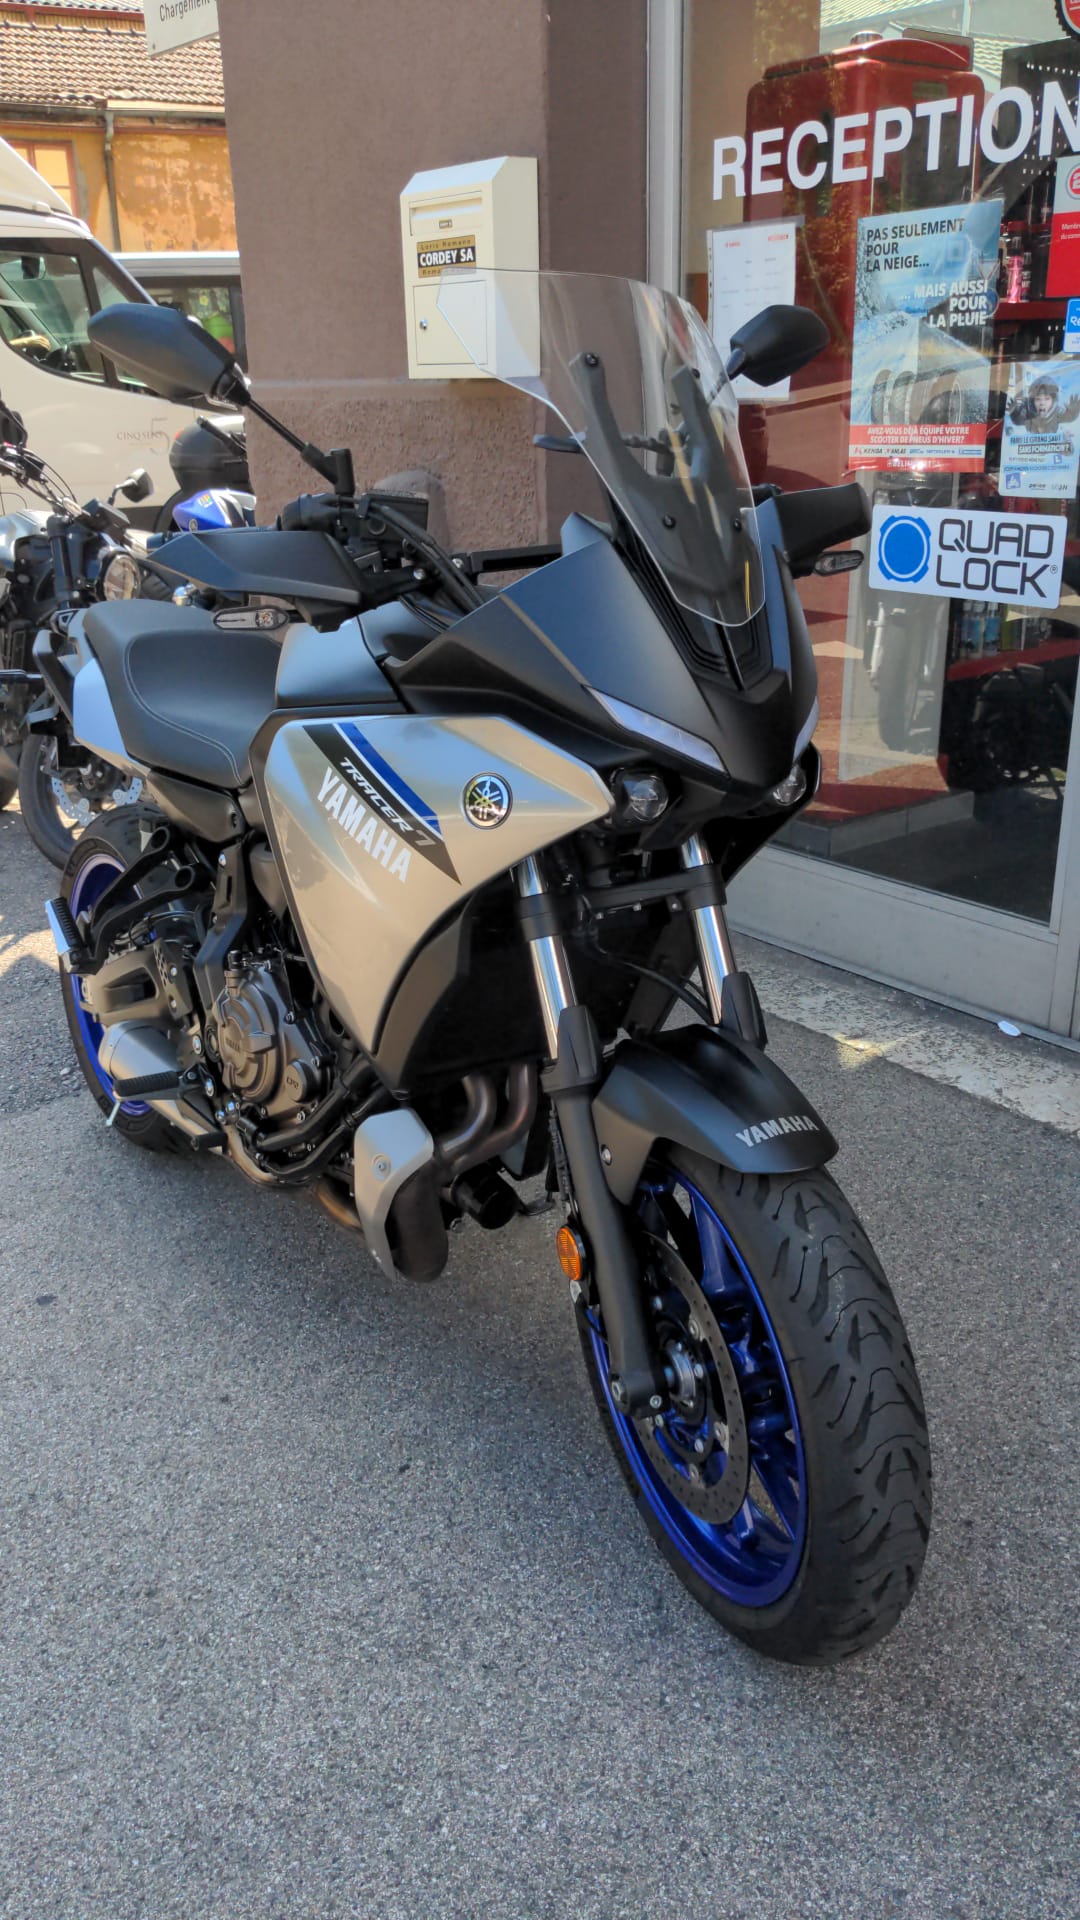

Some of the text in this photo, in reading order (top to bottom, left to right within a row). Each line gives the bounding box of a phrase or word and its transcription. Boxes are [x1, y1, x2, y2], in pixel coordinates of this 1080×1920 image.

[713, 80, 1080, 200] RECEPTION
[866, 218, 965, 242] PAS SEULEMENT
[420, 247, 474, 267] CORDEY SA
[866, 242, 899, 257] POUR
[866, 260, 881, 273] LA
[914, 283, 946, 298] MAIS
[950, 280, 988, 296] AUSSI
[950, 296, 987, 312] POUR
[929, 312, 987, 328] LA PLUIE
[939, 518, 1054, 559] QUAD
[340, 756, 415, 833] TRACER
[317, 765, 412, 884] YAMAHA
[735, 1115, 820, 1148] YAMAHA
